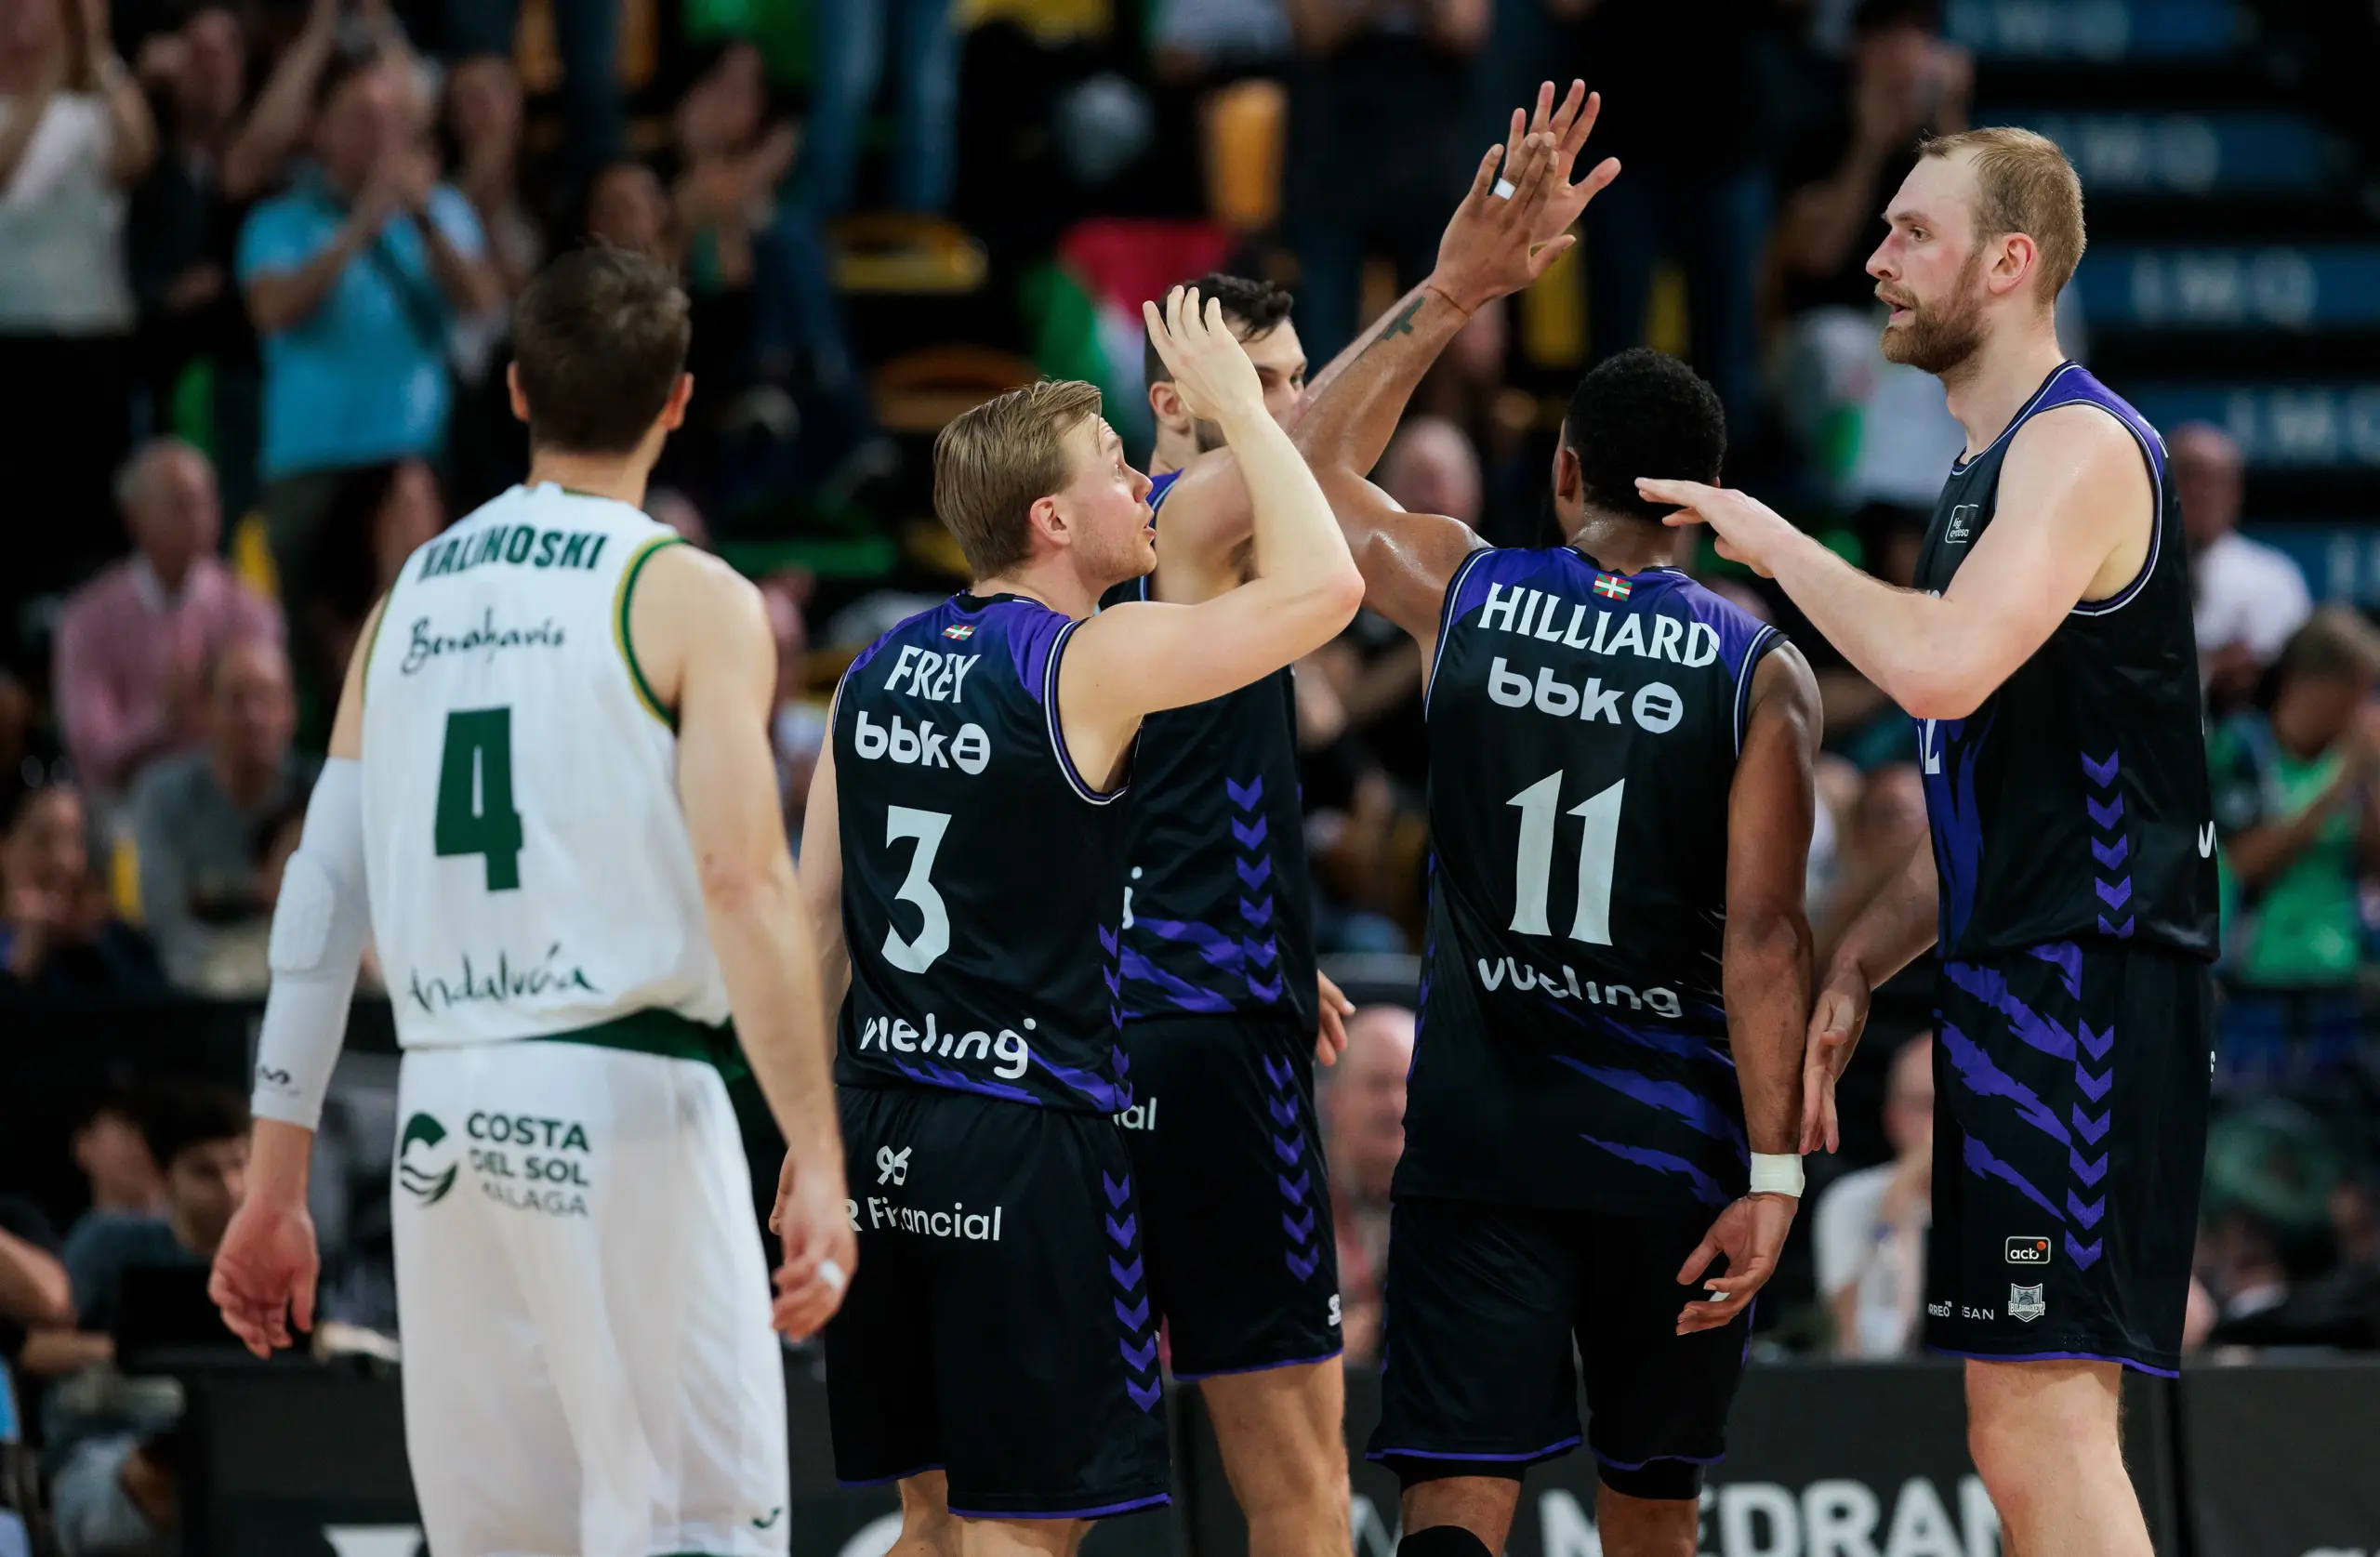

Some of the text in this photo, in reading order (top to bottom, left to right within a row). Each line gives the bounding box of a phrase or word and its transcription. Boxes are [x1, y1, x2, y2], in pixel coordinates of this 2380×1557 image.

[1477, 582, 1720, 667] HILLIARD
[884, 644, 982, 704] FREY
[1488, 656, 1625, 724] bbk
[854, 710, 949, 769] bbk
[434, 706, 524, 891] 4
[1505, 769, 1625, 946] 11
[881, 805, 952, 974] 3
[1477, 957, 1685, 1019] vueling
[467, 1110, 590, 1154] COSTA
[524, 1155, 590, 1187] SOL
[2010, 1247, 2040, 1260] acb
